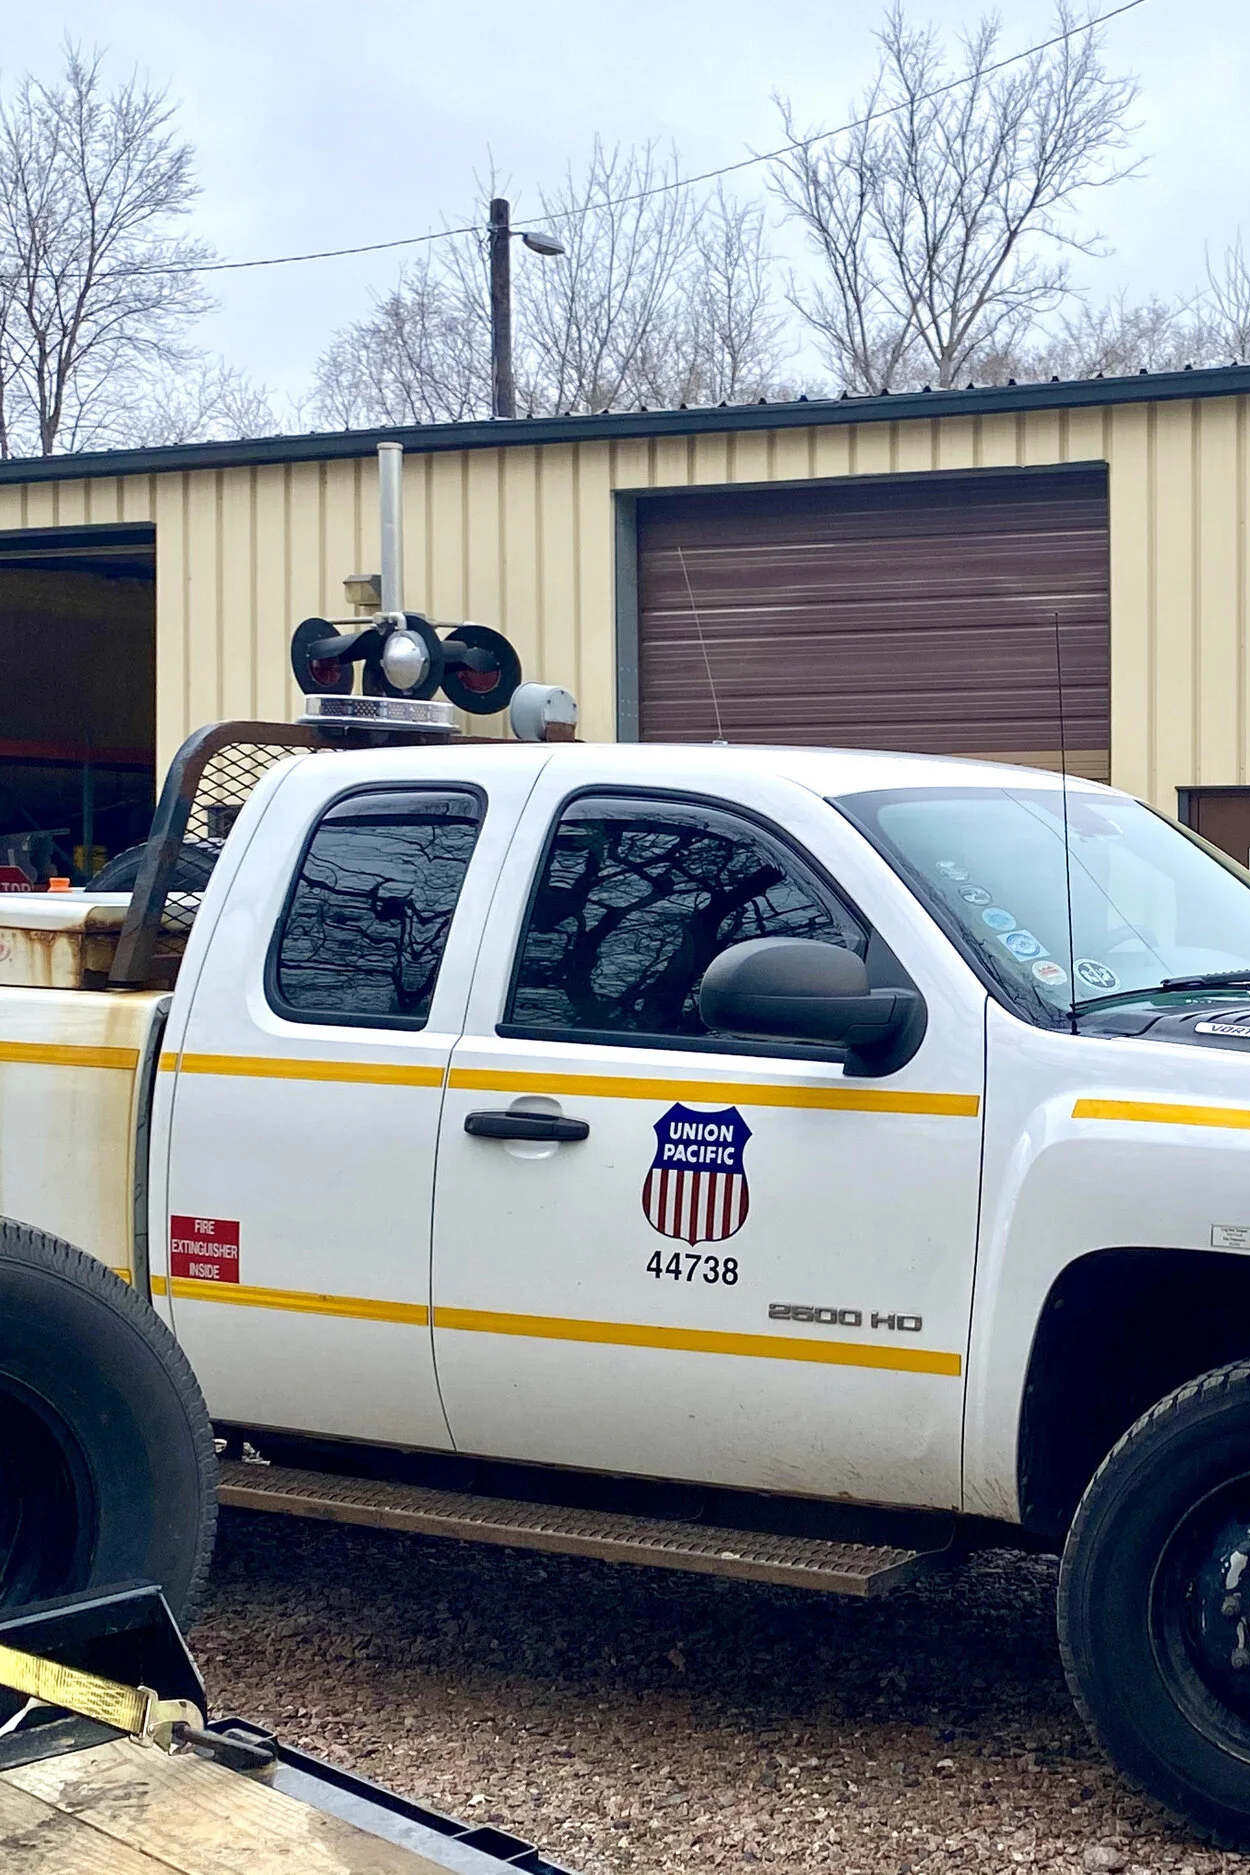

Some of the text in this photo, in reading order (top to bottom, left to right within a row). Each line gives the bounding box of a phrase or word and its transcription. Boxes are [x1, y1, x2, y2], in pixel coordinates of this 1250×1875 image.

[669, 1121, 735, 1143] UNION
[663, 1143, 736, 1166] PACIFIC
[194, 1219, 216, 1235] FIRE
[171, 1238, 238, 1260] EXTINGUISHER
[189, 1262, 220, 1279] INSIDE
[646, 1250, 739, 1286] 44738
[768, 1302, 923, 1332] 2500 HD
